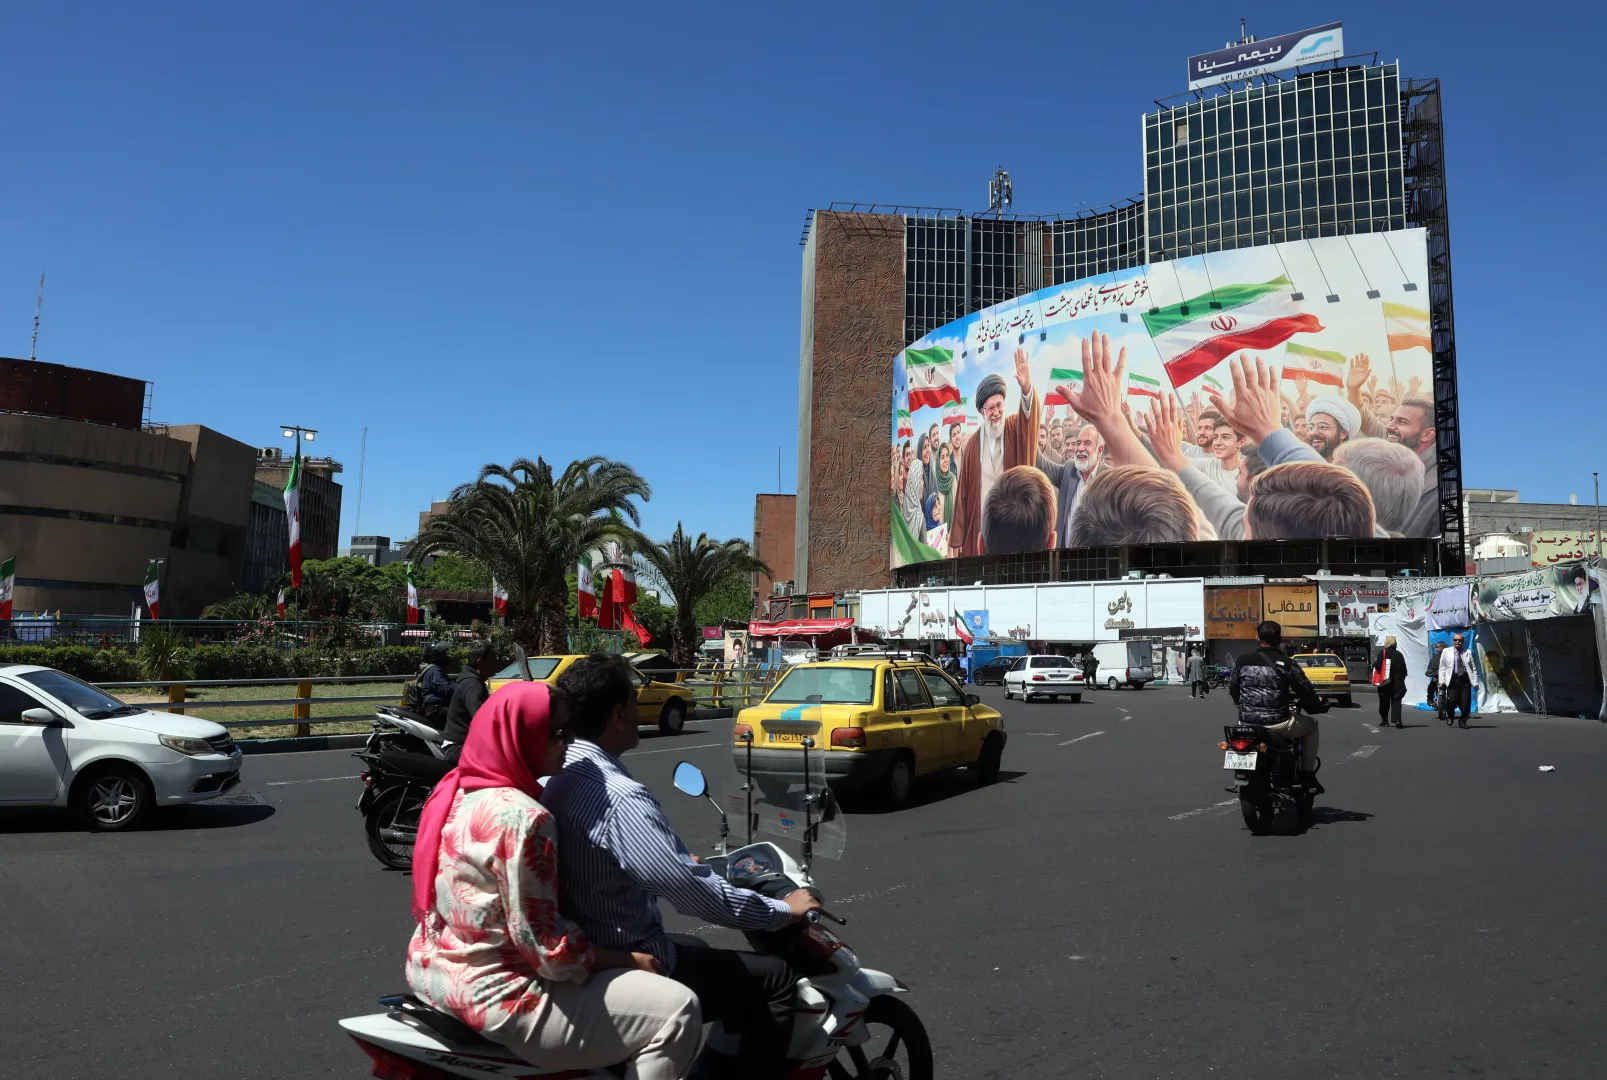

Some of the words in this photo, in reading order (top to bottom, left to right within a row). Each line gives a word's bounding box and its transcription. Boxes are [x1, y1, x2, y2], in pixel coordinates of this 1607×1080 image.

[1238, 45, 1282, 62] بیمه
[1197, 59, 1236, 74] سینا
[1124, 280, 1149, 306] خوش
[1044, 294, 1072, 317] بهشت
[1003, 321, 1010, 333] بر
[1010, 309, 1034, 330] پرچمت
[989, 318, 1004, 339] زمین
[1537, 534, 1572, 546] خرید
[1327, 583, 1353, 599] فود
[1356, 583, 1389, 596] فست
